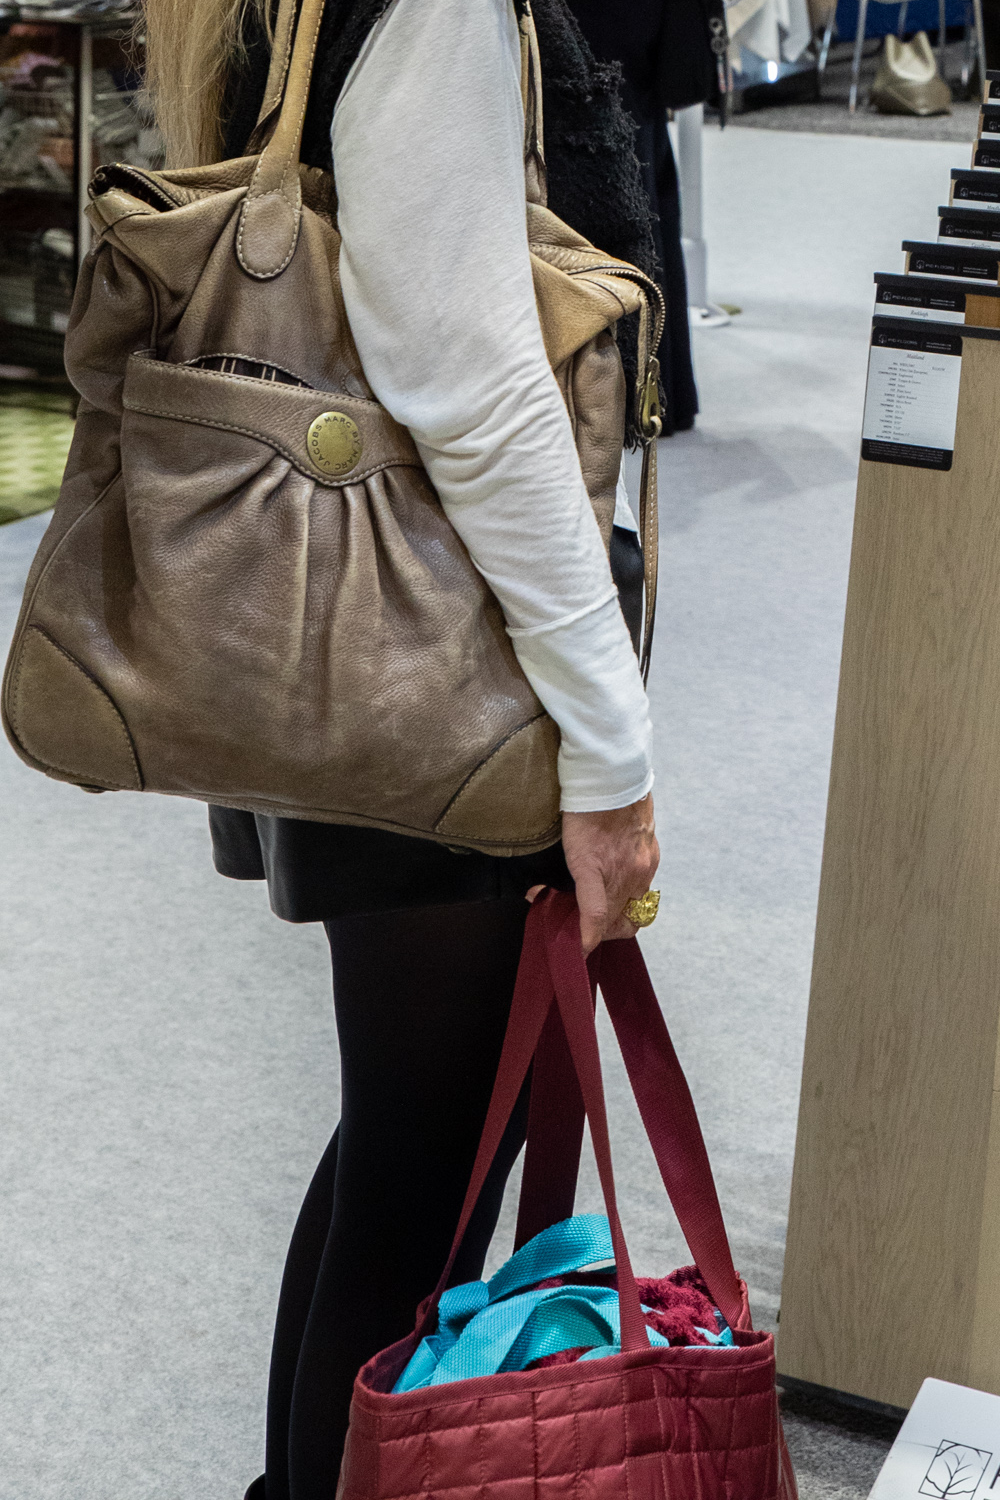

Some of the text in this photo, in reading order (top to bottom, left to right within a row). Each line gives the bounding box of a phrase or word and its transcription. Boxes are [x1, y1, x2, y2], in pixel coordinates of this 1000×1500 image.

[312, 416, 360, 470] MARC BY MARC JACOBS
